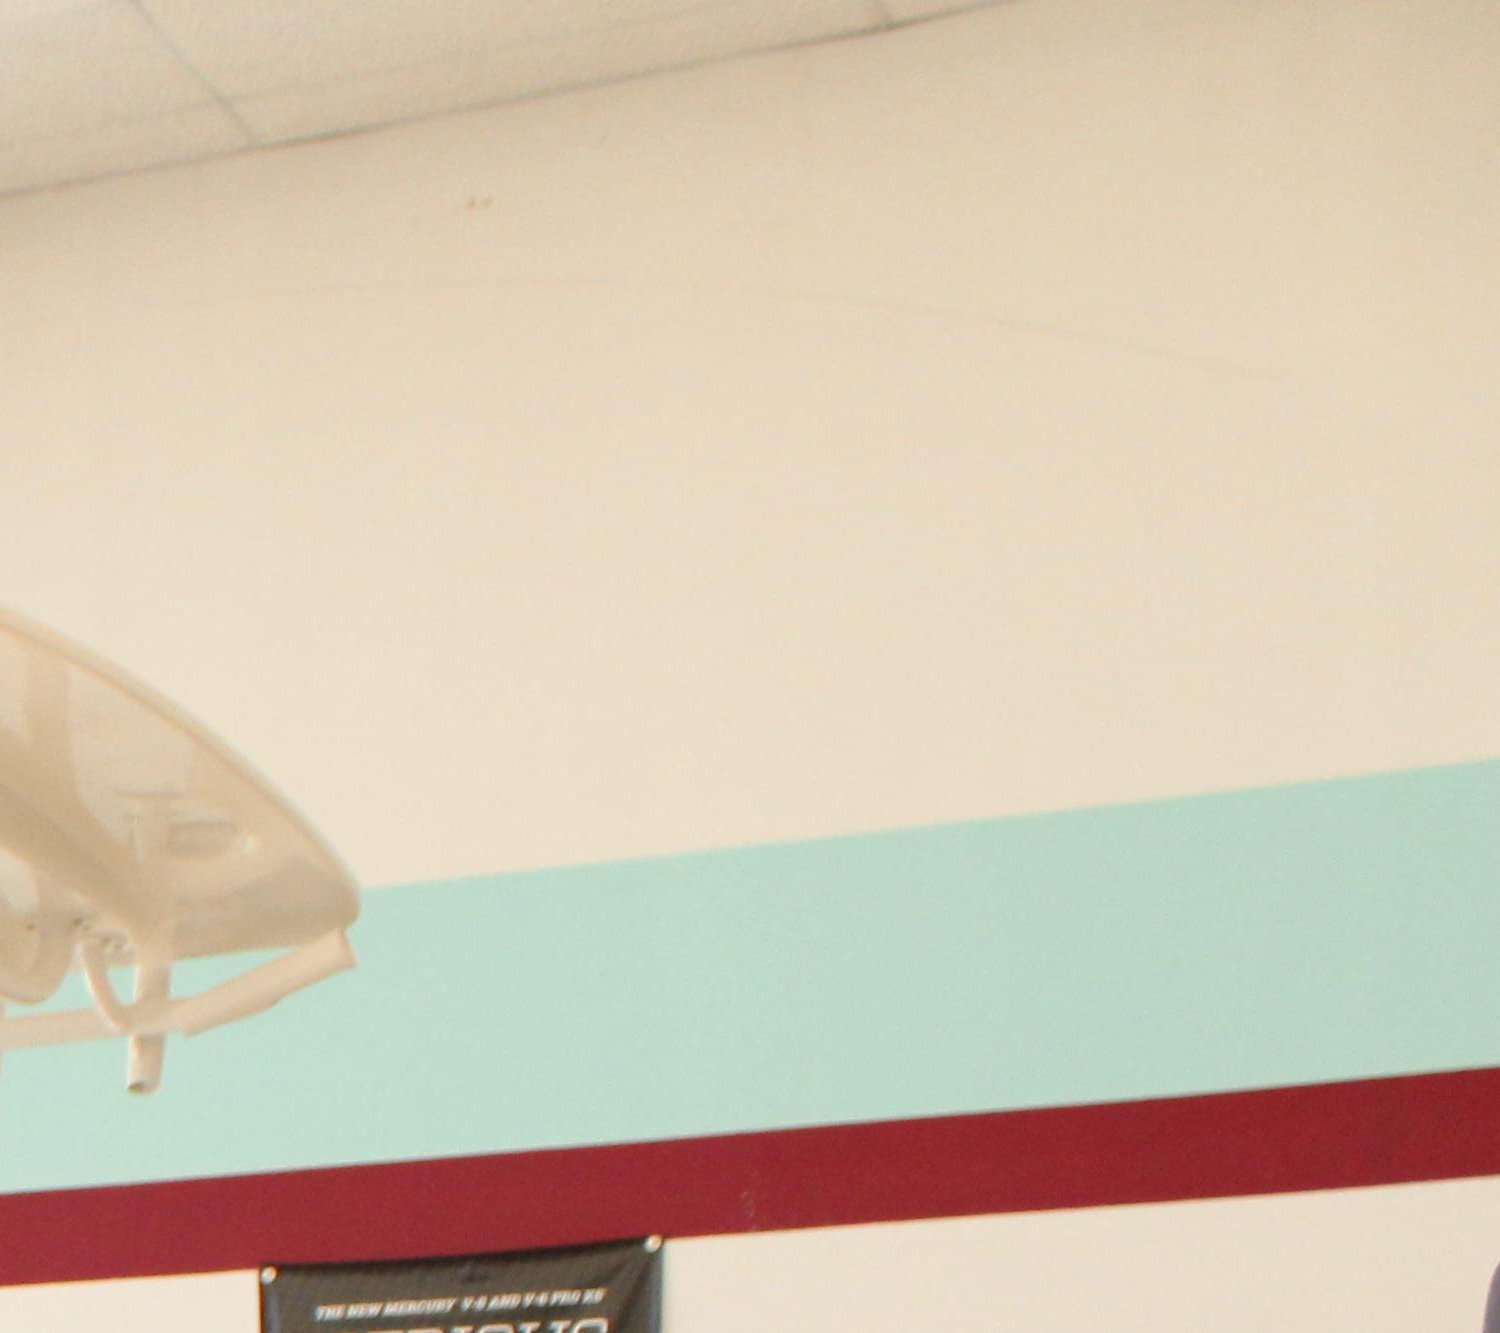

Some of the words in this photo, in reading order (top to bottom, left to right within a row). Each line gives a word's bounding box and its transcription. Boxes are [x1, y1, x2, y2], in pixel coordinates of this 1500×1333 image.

[315, 1303, 343, 1321] THE
[346, 1302, 383, 1319] NEW
[382, 1298, 457, 1317] MERCURY
